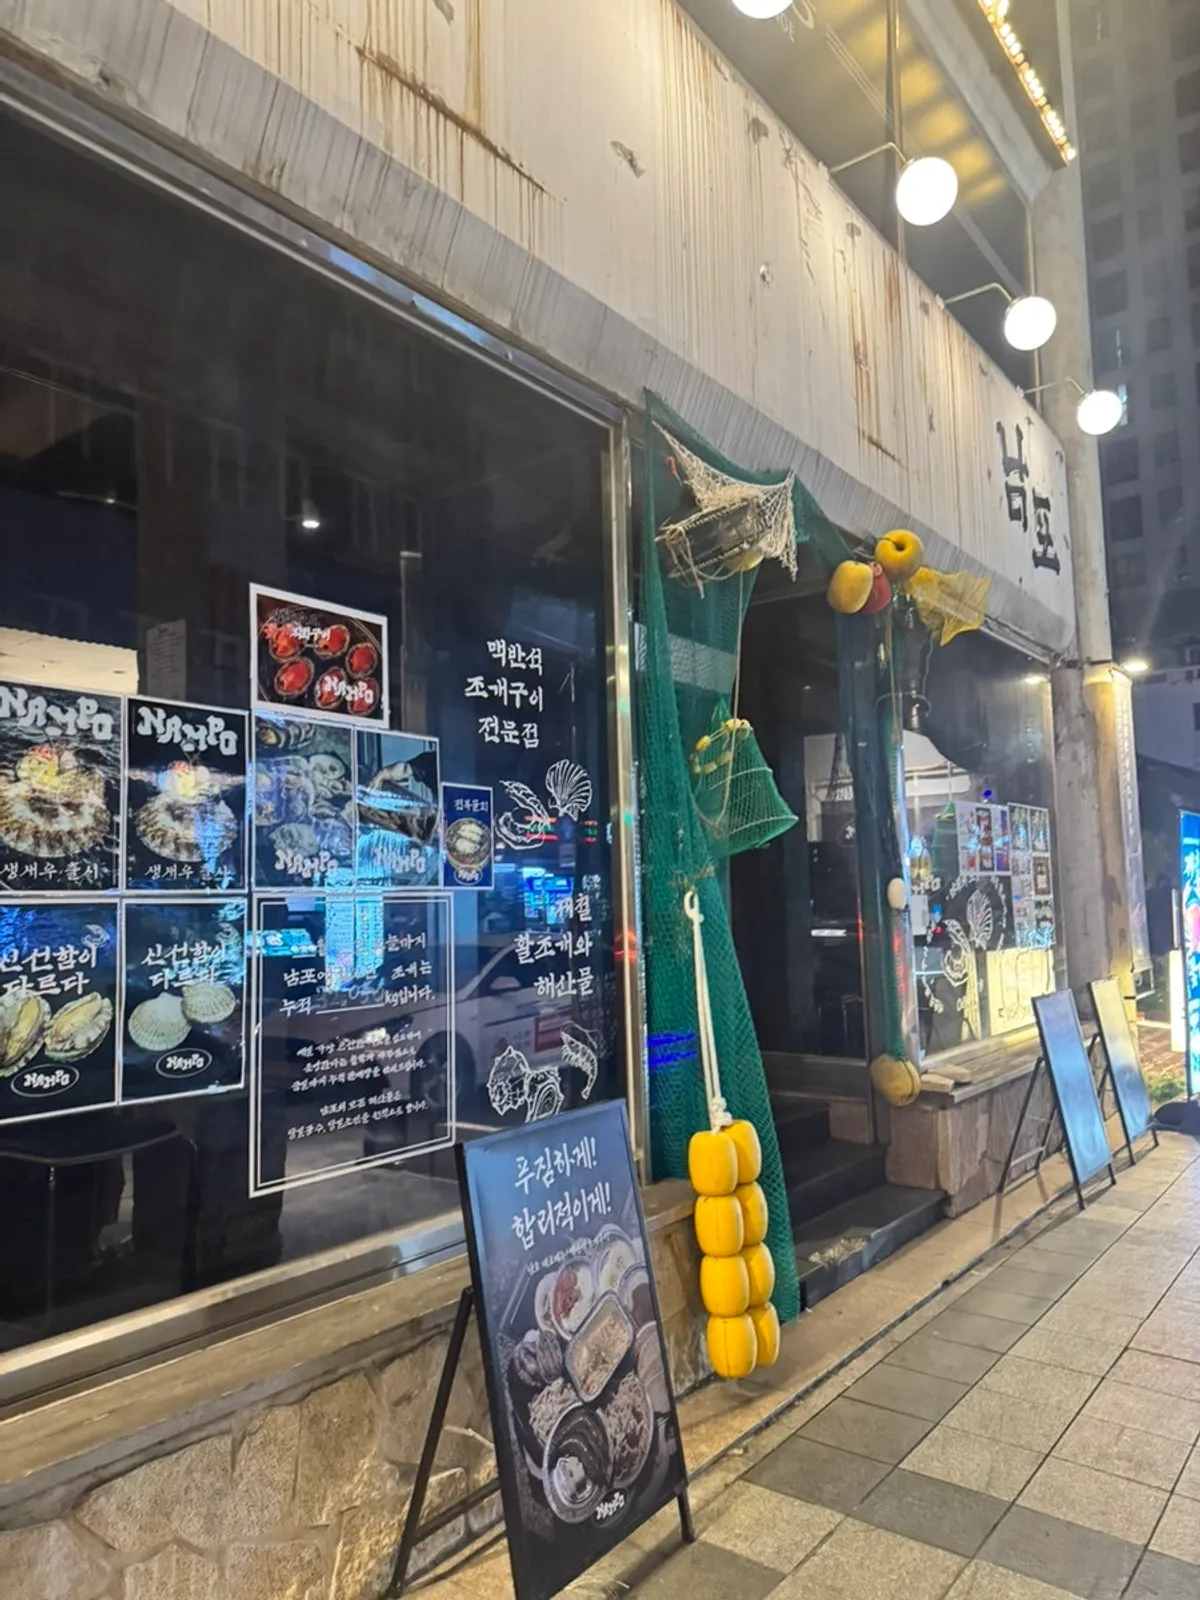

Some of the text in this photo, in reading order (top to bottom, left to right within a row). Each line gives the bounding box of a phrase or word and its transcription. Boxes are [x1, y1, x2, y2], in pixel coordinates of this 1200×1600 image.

[996, 420, 1061, 576] 남포
[486, 638, 543, 677] 맥반석
[464, 675, 544, 713] 조개구이
[136, 706, 238, 755] NAMPO
[478, 714, 540, 750] 전문점
[0, 862, 58, 880] 생새우
[144, 864, 194, 881] 생새우
[141, 941, 227, 967] 신선함이
[514, 930, 594, 965] 활조개와
[2, 971, 90, 995] 다르다
[391, 960, 433, 981] 조개는
[534, 966, 594, 1000] 해산물
[514, 1136, 598, 1195] 푸짐하게!
[511, 1182, 612, 1251] 합리적이게!
